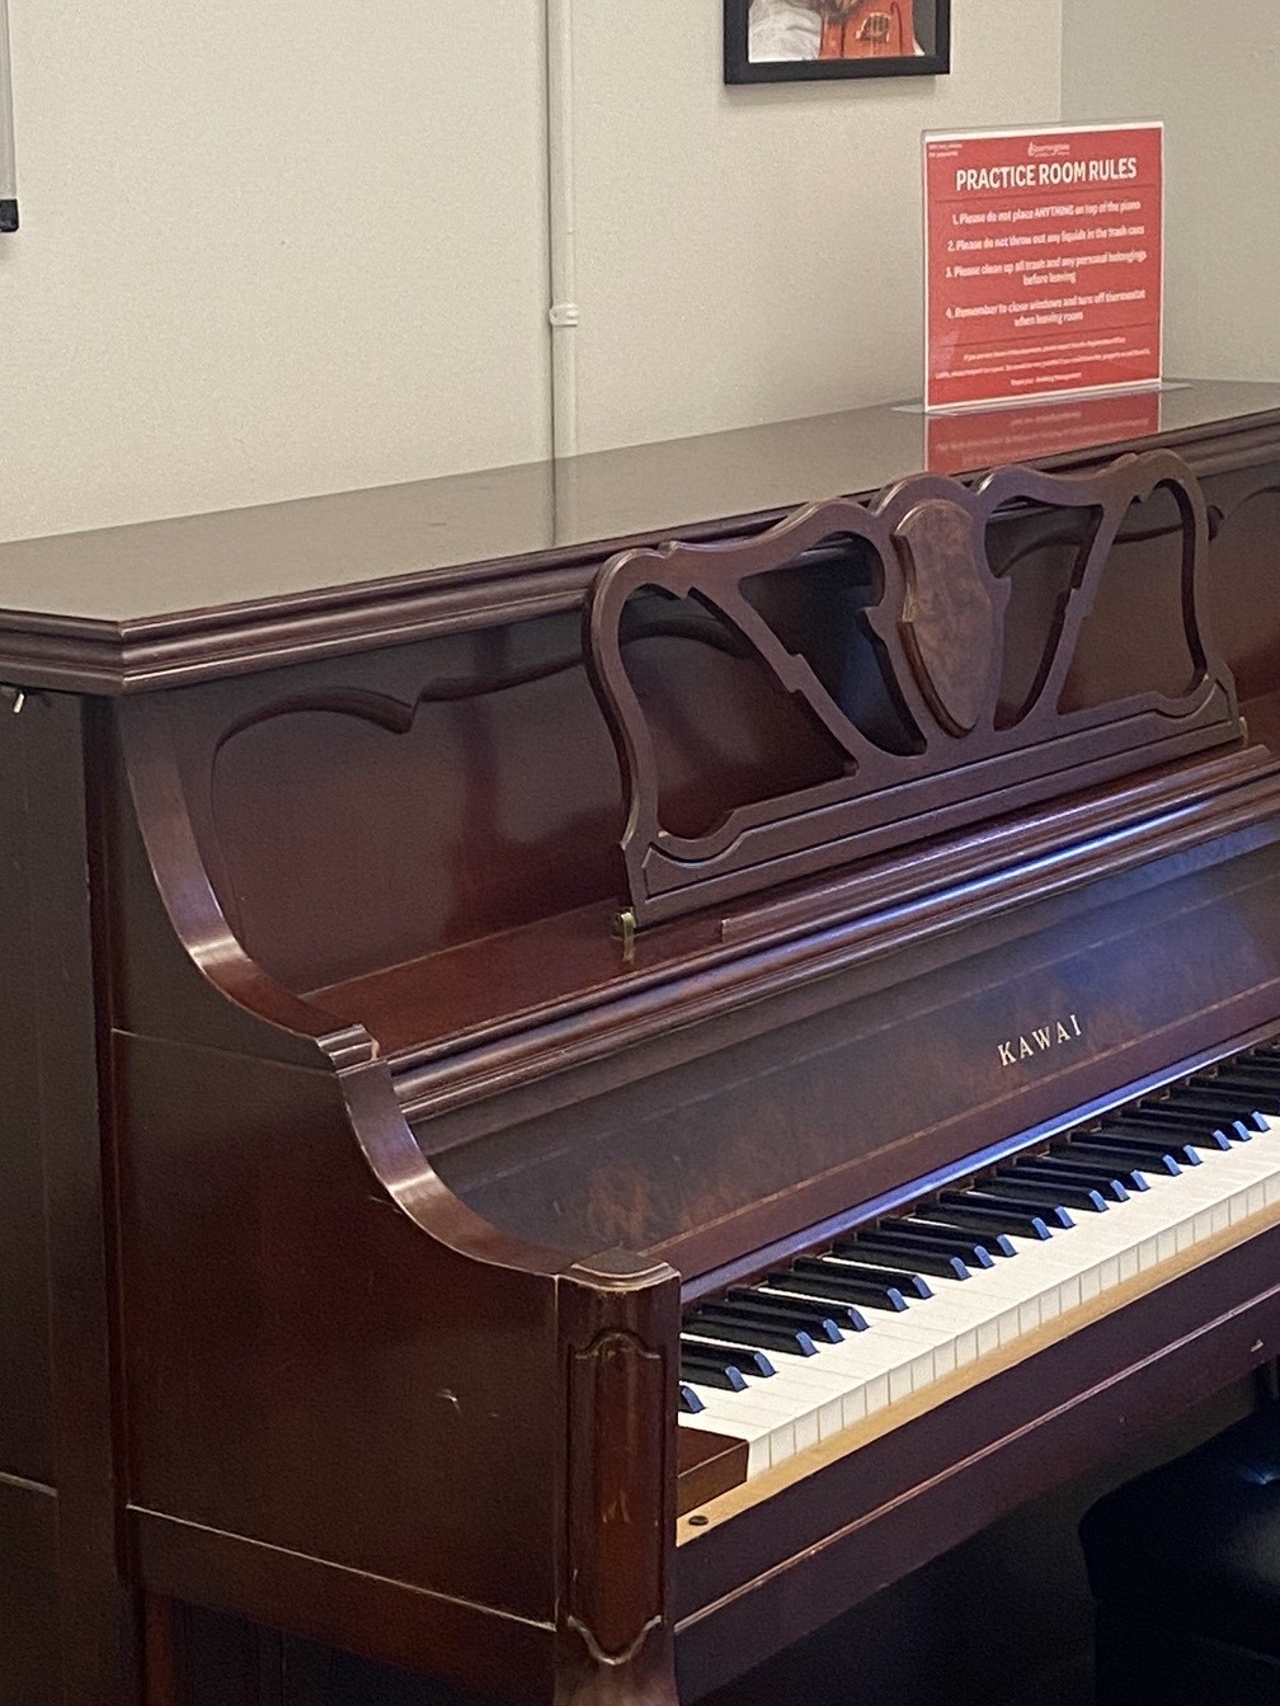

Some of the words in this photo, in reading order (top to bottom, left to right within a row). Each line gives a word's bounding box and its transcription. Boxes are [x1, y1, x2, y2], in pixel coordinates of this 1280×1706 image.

[956, 165, 1036, 191] PRACTICE
[1039, 161, 1086, 184] ROOM
[1089, 157, 1137, 182] RULES
[959, 212, 985, 224] Please
[987, 210, 997, 222] do
[998, 210, 1011, 221] not
[1012, 208, 1033, 222] place
[1034, 204, 1074, 217] ANYTHING
[1085, 204, 1098, 216] top
[1107, 200, 1119, 212] the
[1120, 199, 1141, 213] piano
[947, 240, 955, 252] 2.
[956, 239, 982, 250] Please
[983, 237, 993, 249] do
[995, 237, 1009, 248] not
[1009, 235, 1032, 246] throw
[1033, 234, 1046, 244] out
[1047, 234, 1060, 244] any
[1095, 227, 1107, 239] the
[1108, 225, 1127, 239] trash
[954, 265, 980, 278] Please
[981, 263, 1003, 274] clean
[1003, 263, 1014, 275] up
[1015, 259, 1024, 272] all
[1025, 259, 1045, 270] trash
[1046, 257, 1061, 268] and
[1061, 258, 1075, 269] any
[1076, 252, 1108, 268] personal
[1022, 273, 1048, 286] before
[1048, 272, 1076, 284] leaving
[955, 304, 998, 318] Remember
[998, 304, 1007, 313] to
[1008, 301, 1028, 313] close
[1029, 299, 1062, 310] windows
[1063, 295, 1077, 307] and
[1094, 292, 1105, 304] off
[1105, 289, 1146, 302] thermostat
[1014, 315, 1035, 327] when
[1036, 312, 1063, 325] leaving
[1064, 311, 1084, 321] room
[997, 1014, 1082, 1066] KAWAI
